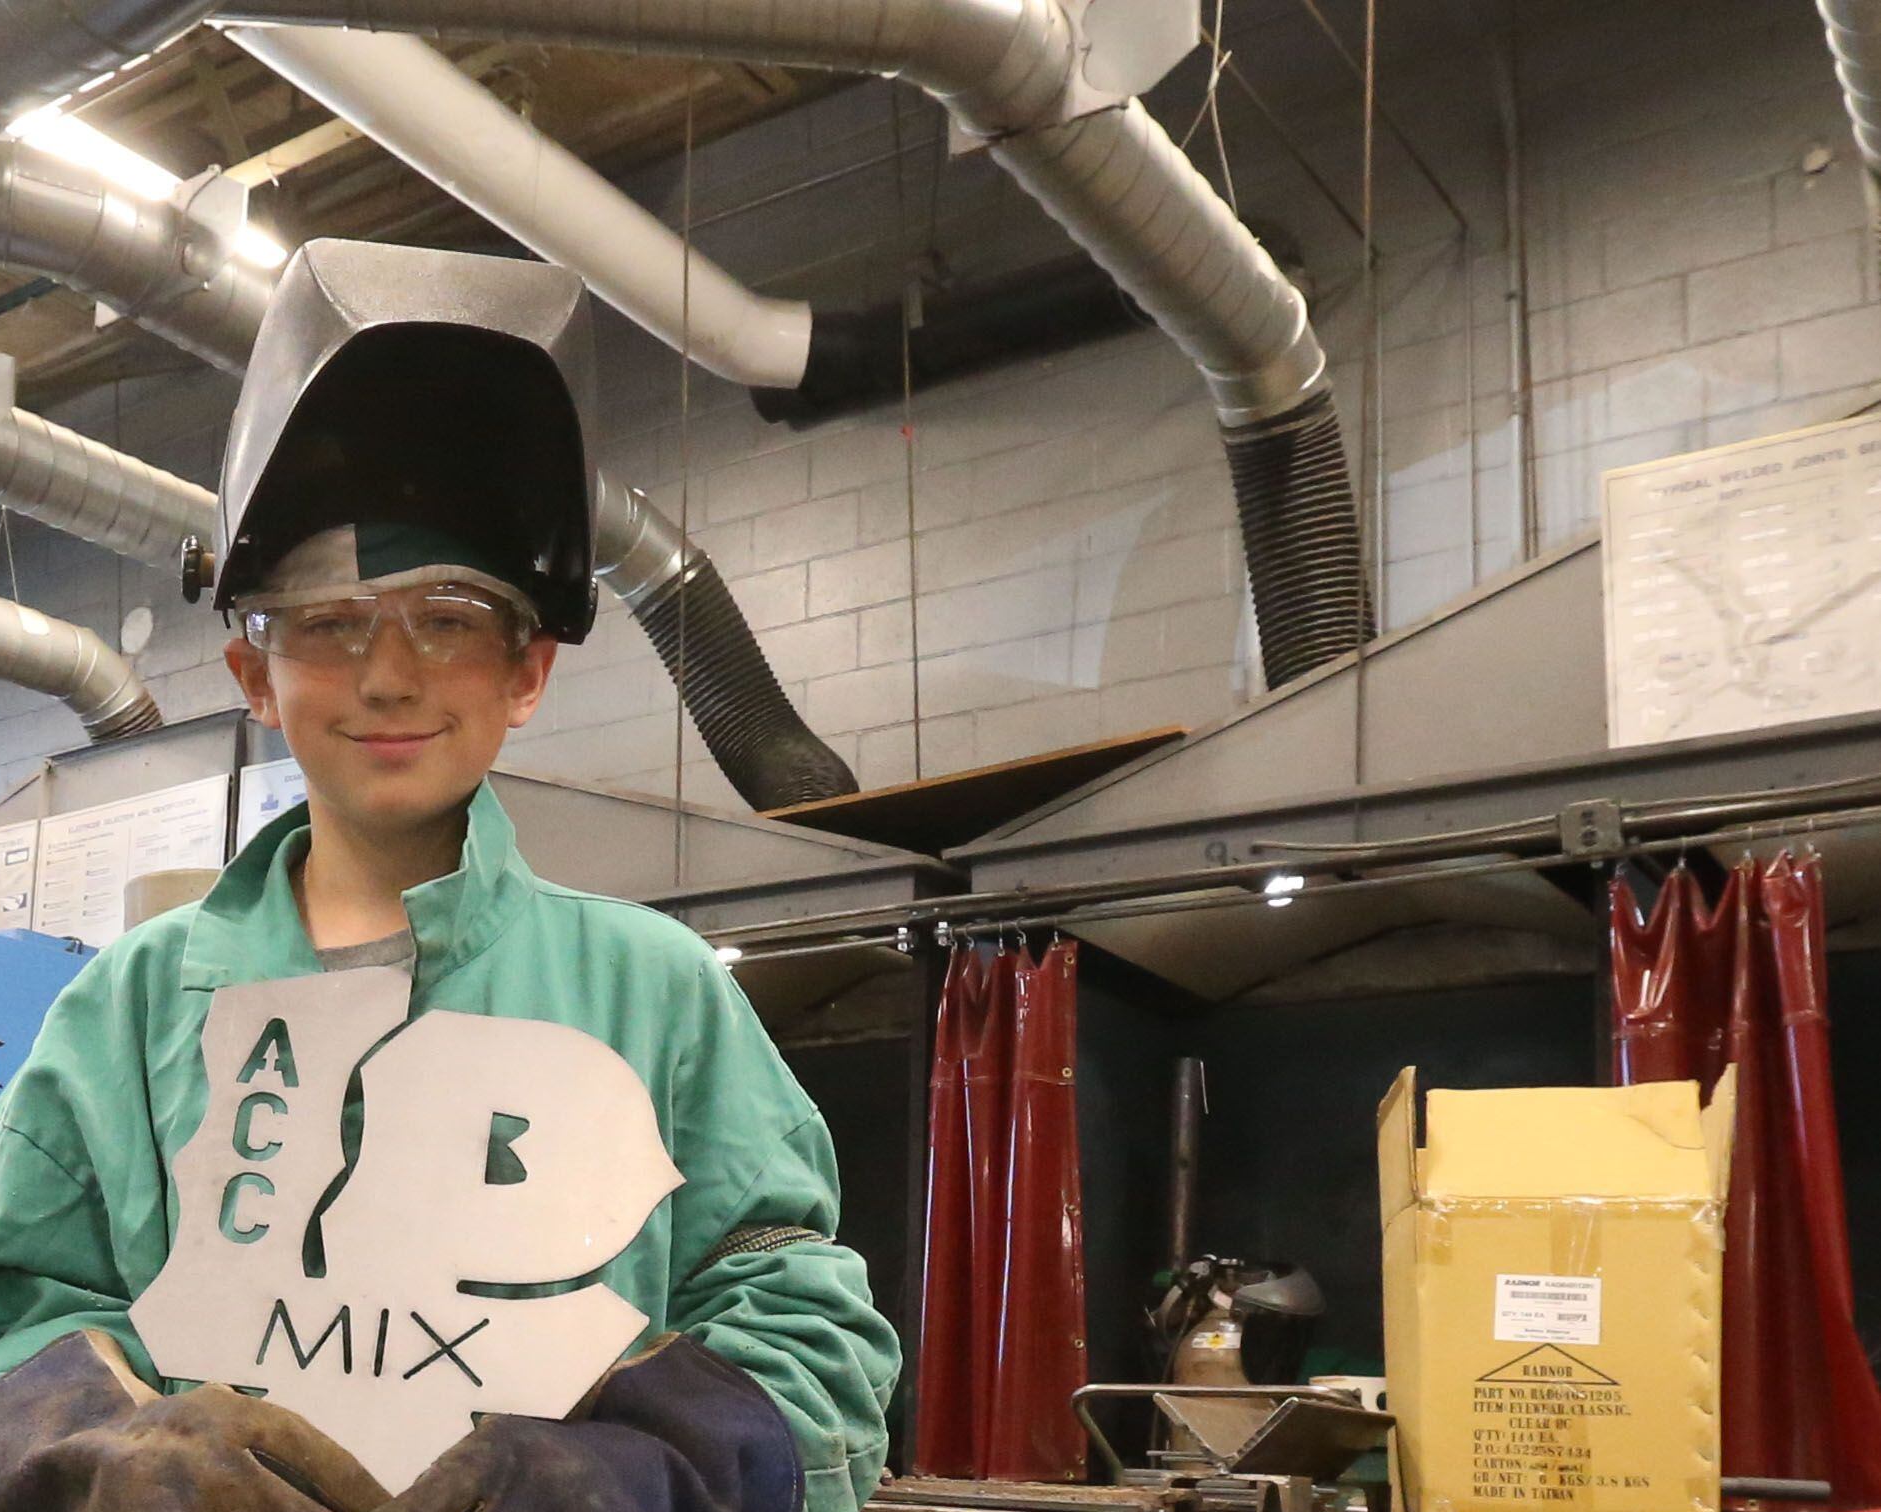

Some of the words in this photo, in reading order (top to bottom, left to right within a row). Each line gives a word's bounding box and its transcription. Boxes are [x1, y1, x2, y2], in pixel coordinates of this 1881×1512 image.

[255, 1298, 490, 1388] MIX
[1522, 1364, 1573, 1377] RADNOR
[1473, 1387, 1504, 1400] PART
[1509, 1417, 1550, 1429] CLEAR
[1624, 1476, 1650, 1488] KGS
[1473, 1486, 1506, 1498] MADE
[1513, 1487, 1526, 1499] IN
[1531, 1487, 1575, 1501] TAIWAN
